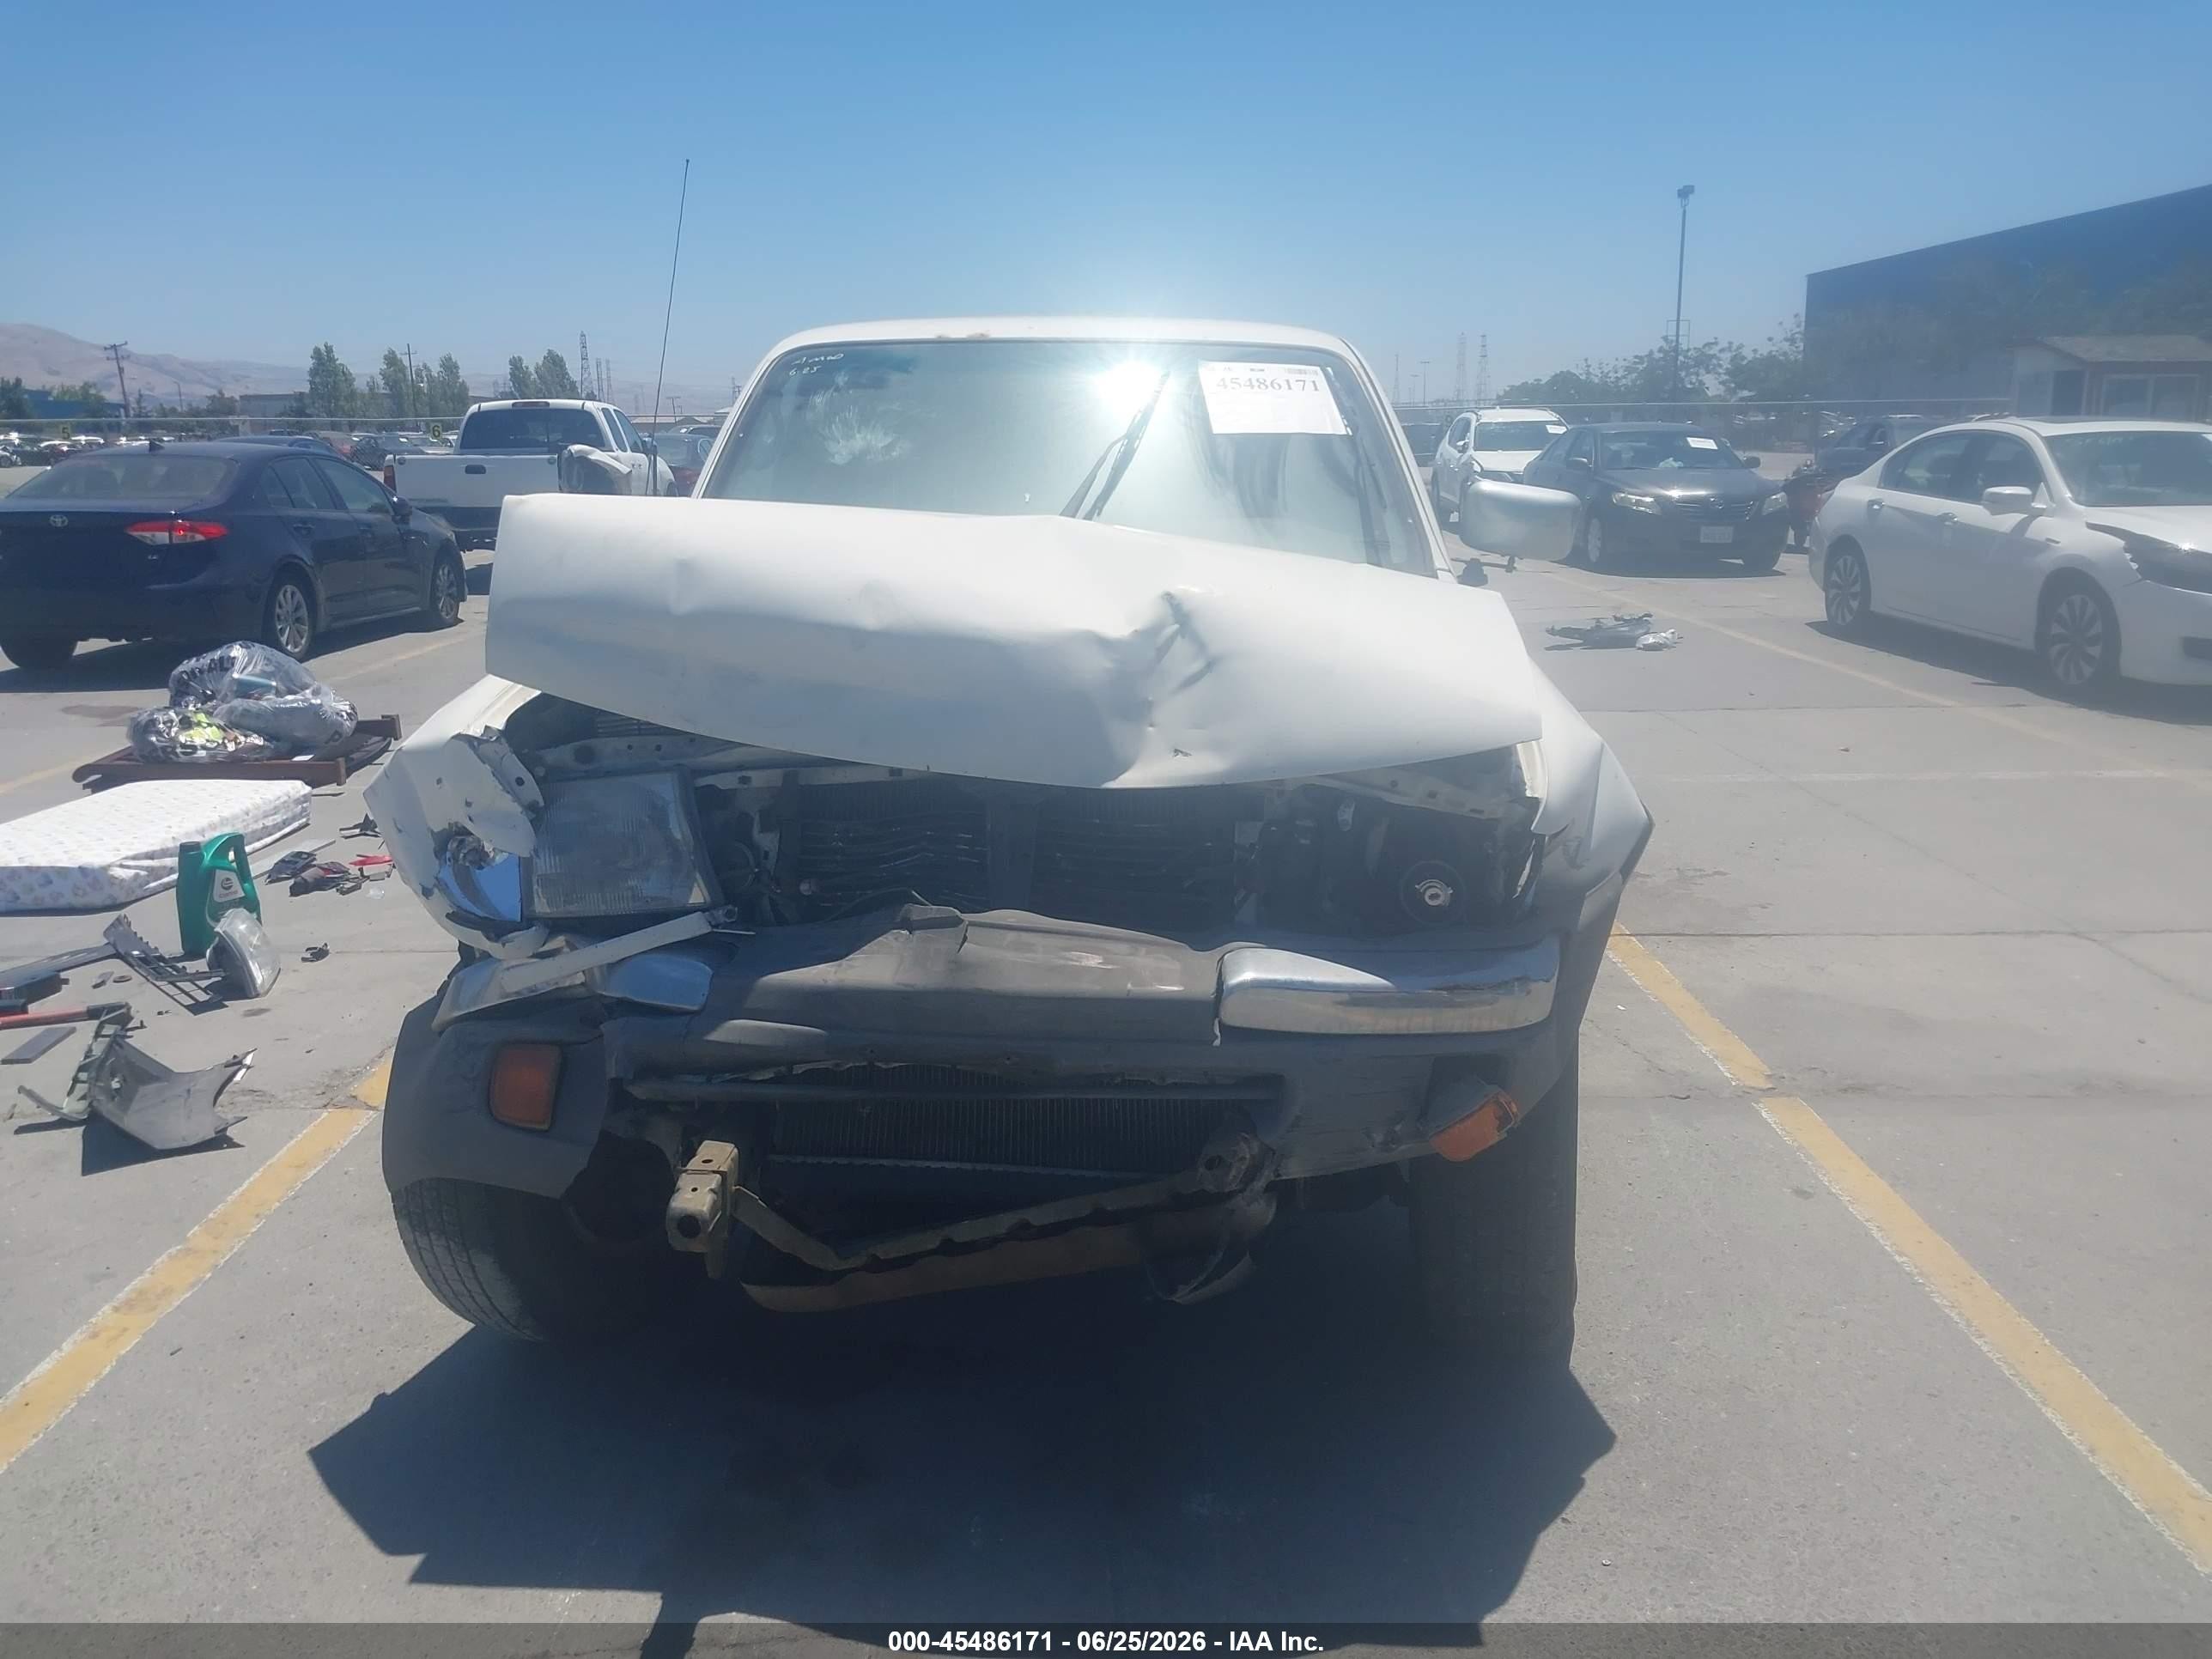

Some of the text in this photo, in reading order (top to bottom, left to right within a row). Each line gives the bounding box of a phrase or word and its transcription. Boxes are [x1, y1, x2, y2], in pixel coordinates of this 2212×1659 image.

[1216, 377, 1320, 392] 45486171
[61, 427, 70, 440] 5
[432, 425, 441, 438] 6
